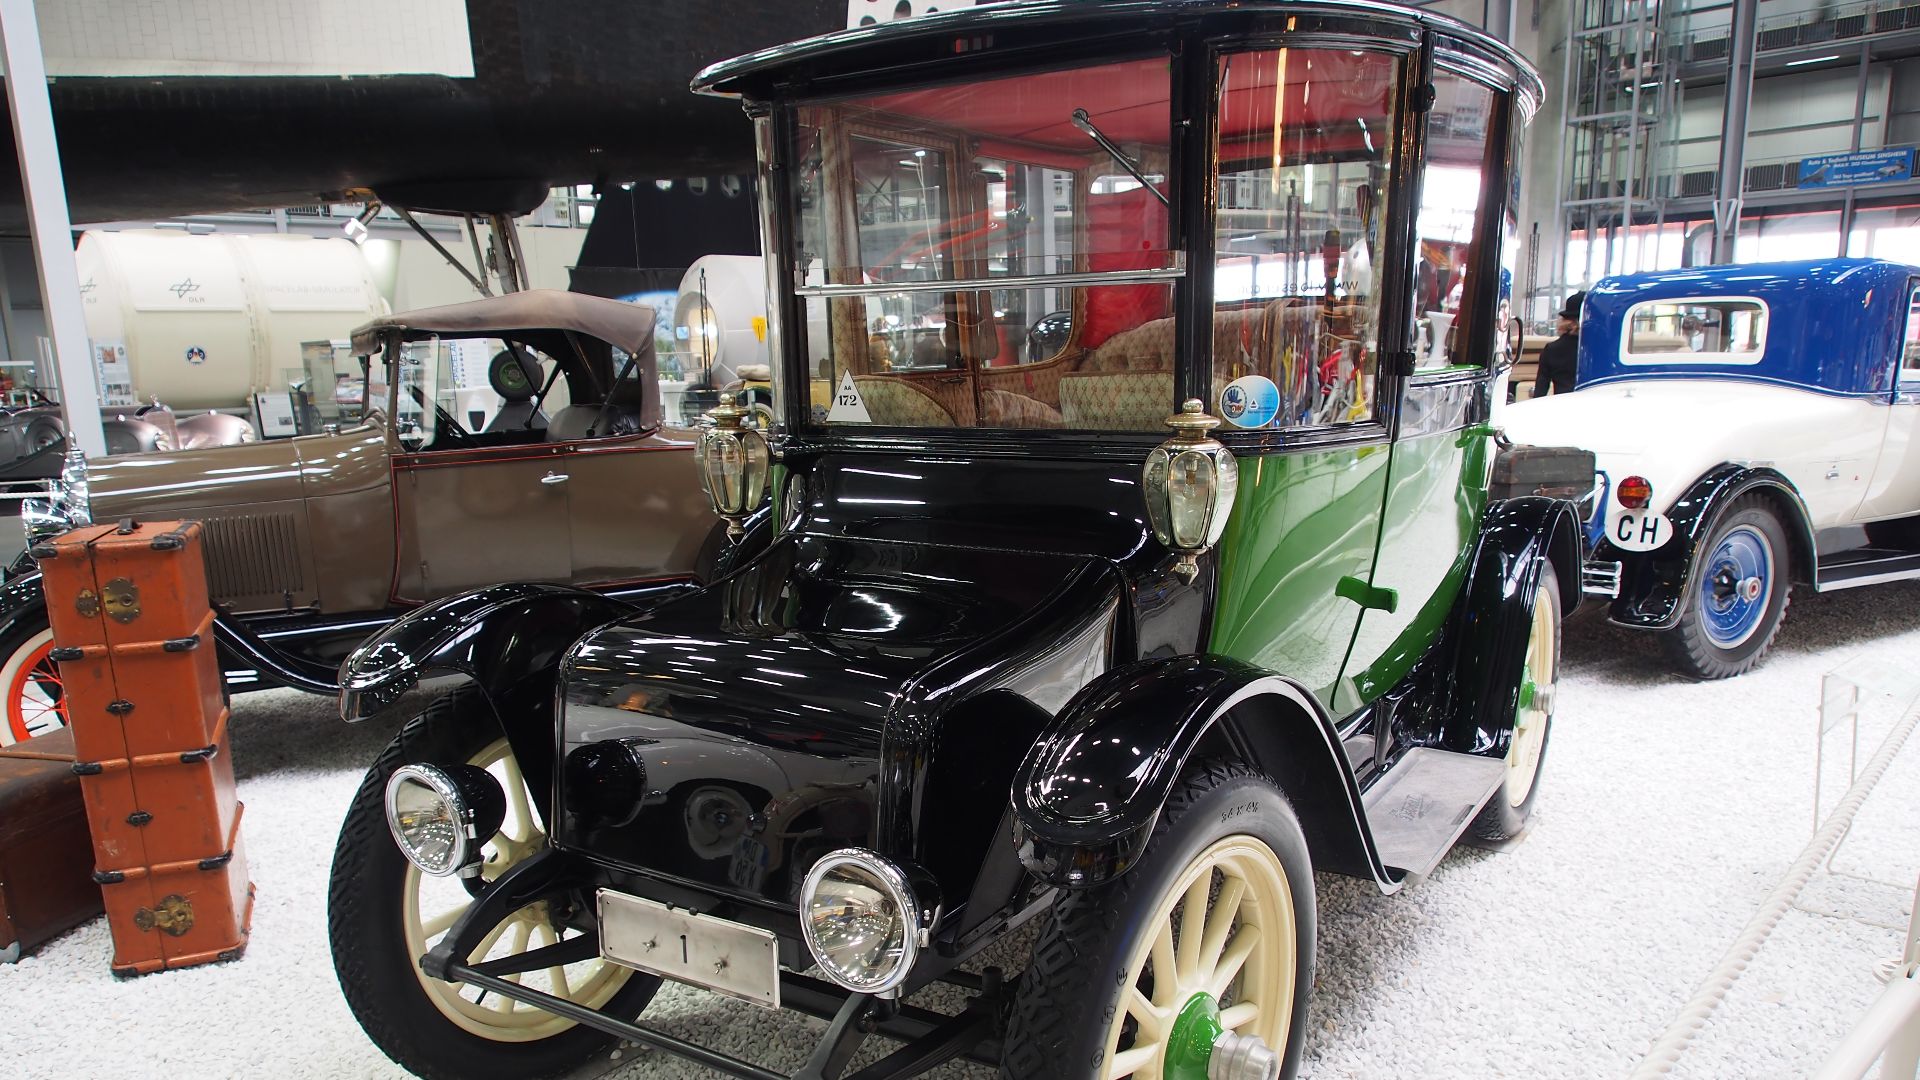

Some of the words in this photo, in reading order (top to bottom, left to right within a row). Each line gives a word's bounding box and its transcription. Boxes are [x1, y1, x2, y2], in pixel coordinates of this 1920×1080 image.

[1877, 151, 1907, 160] SINSHEIM
[838, 394, 857, 406] 172
[679, 934, 688, 964] 1
